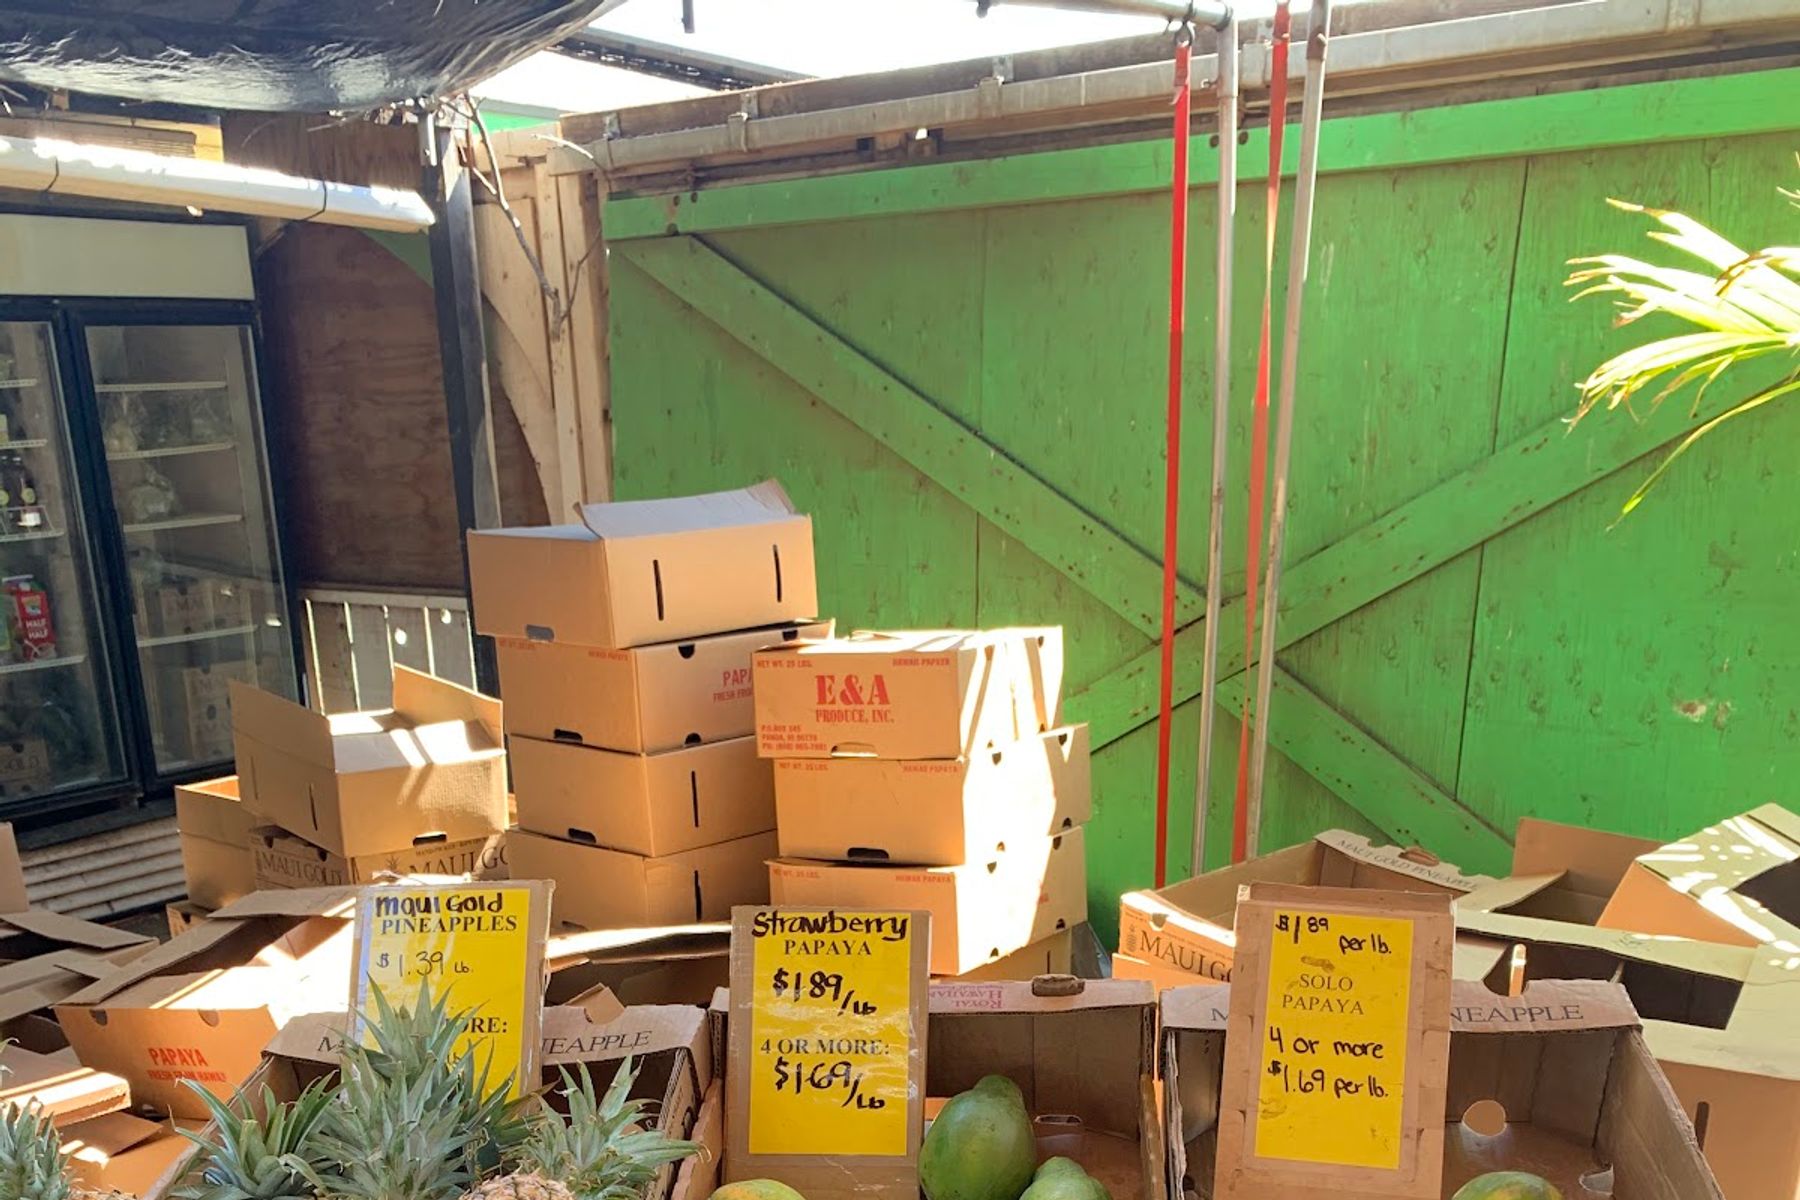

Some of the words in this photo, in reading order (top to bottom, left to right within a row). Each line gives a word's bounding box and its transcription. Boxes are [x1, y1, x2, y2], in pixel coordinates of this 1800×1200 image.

[815, 674, 890, 705] E&A
[815, 709, 869, 723] PRODUCE,
[872, 709, 894, 723] INC.
[381, 915, 518, 935] PINEAPPLES
[752, 910, 909, 941] Strawberry
[784, 940, 872, 955] PAPAYA
[1140, 929, 1206, 977] MAUI
[1339, 935, 1366, 954] per
[1300, 974, 1353, 991] SOLO
[1282, 994, 1364, 1015] PAPAYA
[761, 1039, 771, 1054] 4
[777, 1039, 810, 1054] OR
[815, 1039, 890, 1055] MORE:
[1269, 1026, 1284, 1053] 4
[1334, 1040, 1384, 1058] more
[148, 1047, 208, 1066] PAPAYA
[1334, 1077, 1363, 1098] per
